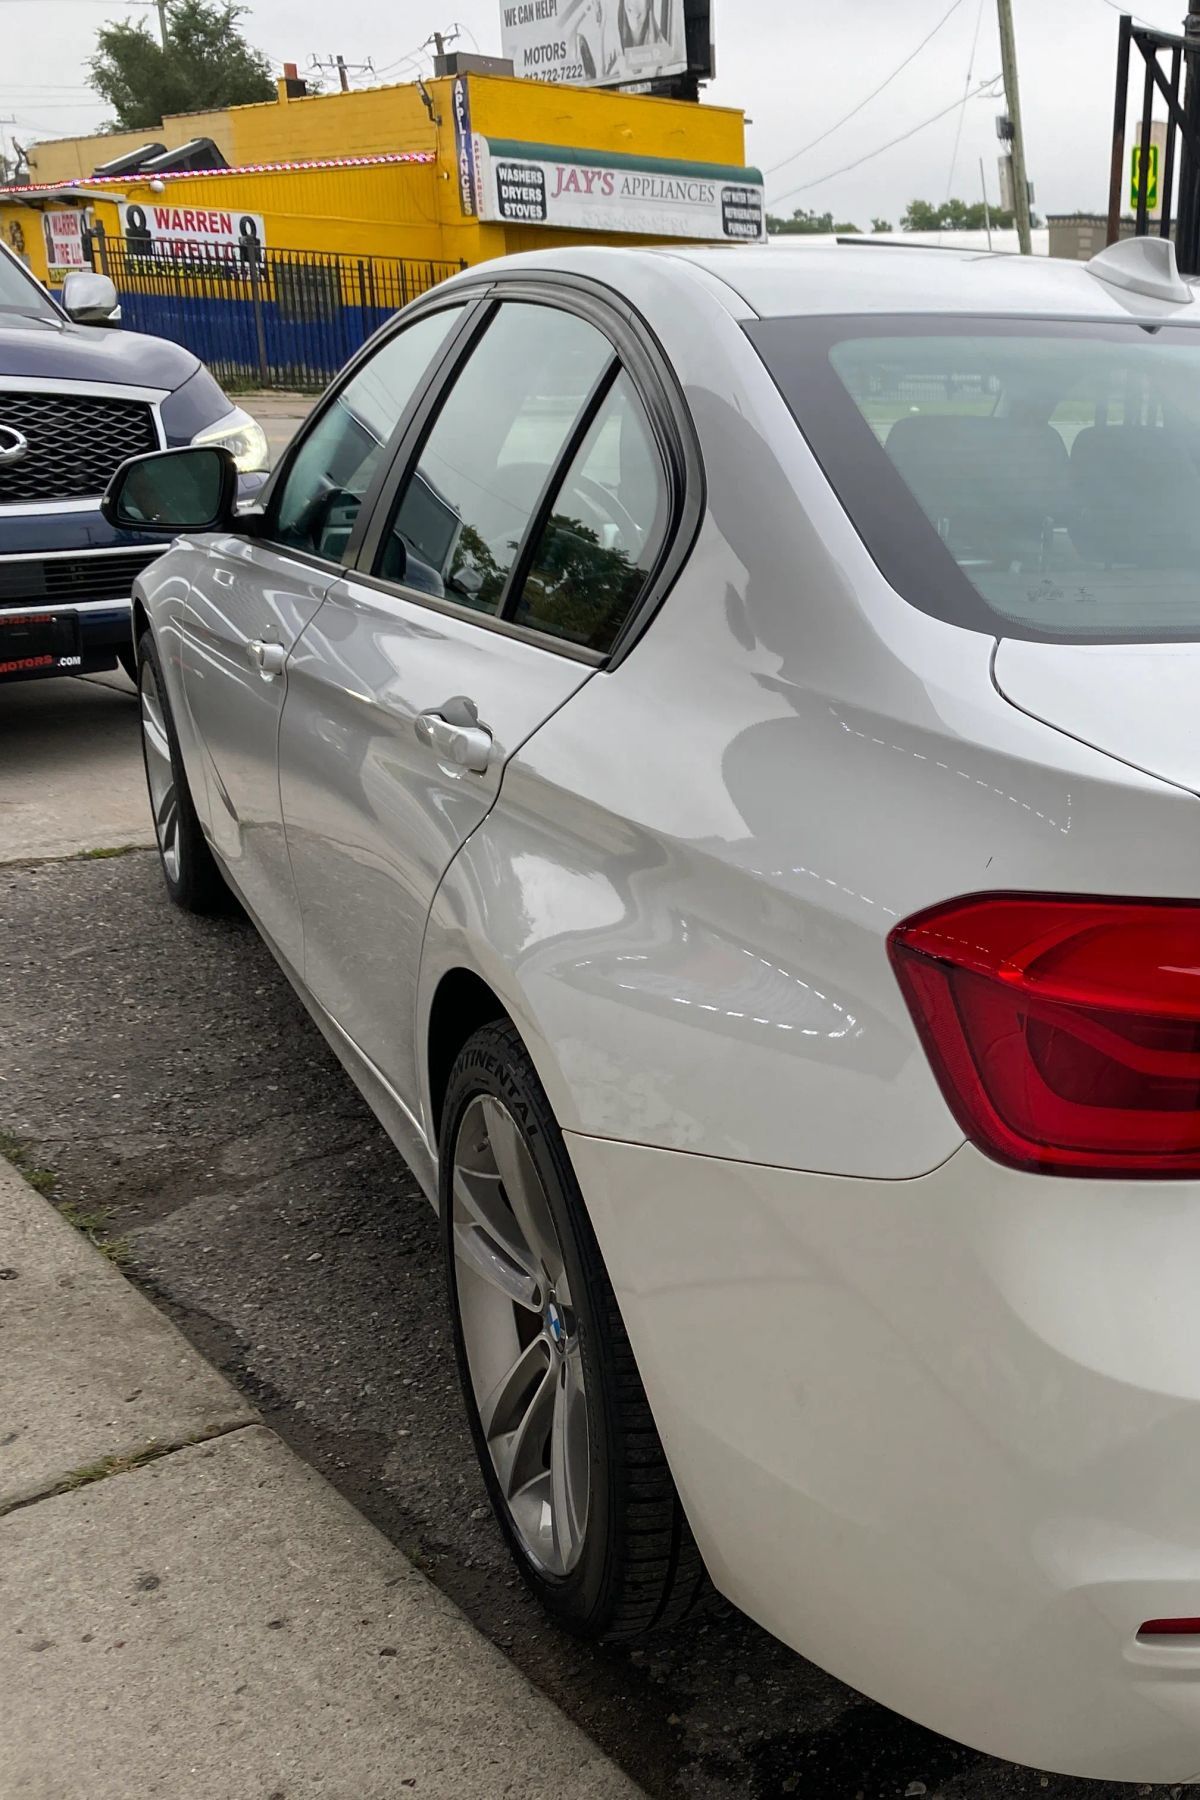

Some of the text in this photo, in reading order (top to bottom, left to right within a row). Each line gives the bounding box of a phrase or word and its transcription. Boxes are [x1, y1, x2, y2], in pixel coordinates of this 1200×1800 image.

[504, 0, 558, 28] WE CAN HELP!
[523, 41, 566, 66] MOTORS
[454, 79, 472, 216] APPLIANCES
[474, 139, 484, 213] APPLIANCES
[499, 167, 543, 184] WASHERS
[551, 166, 716, 204] JAY'S APPLIANCES
[501, 186, 543, 201] DRYERS
[153, 207, 233, 234] WARREN
[503, 202, 543, 218] STOVES
[57, 655, 81, 668] .COM
